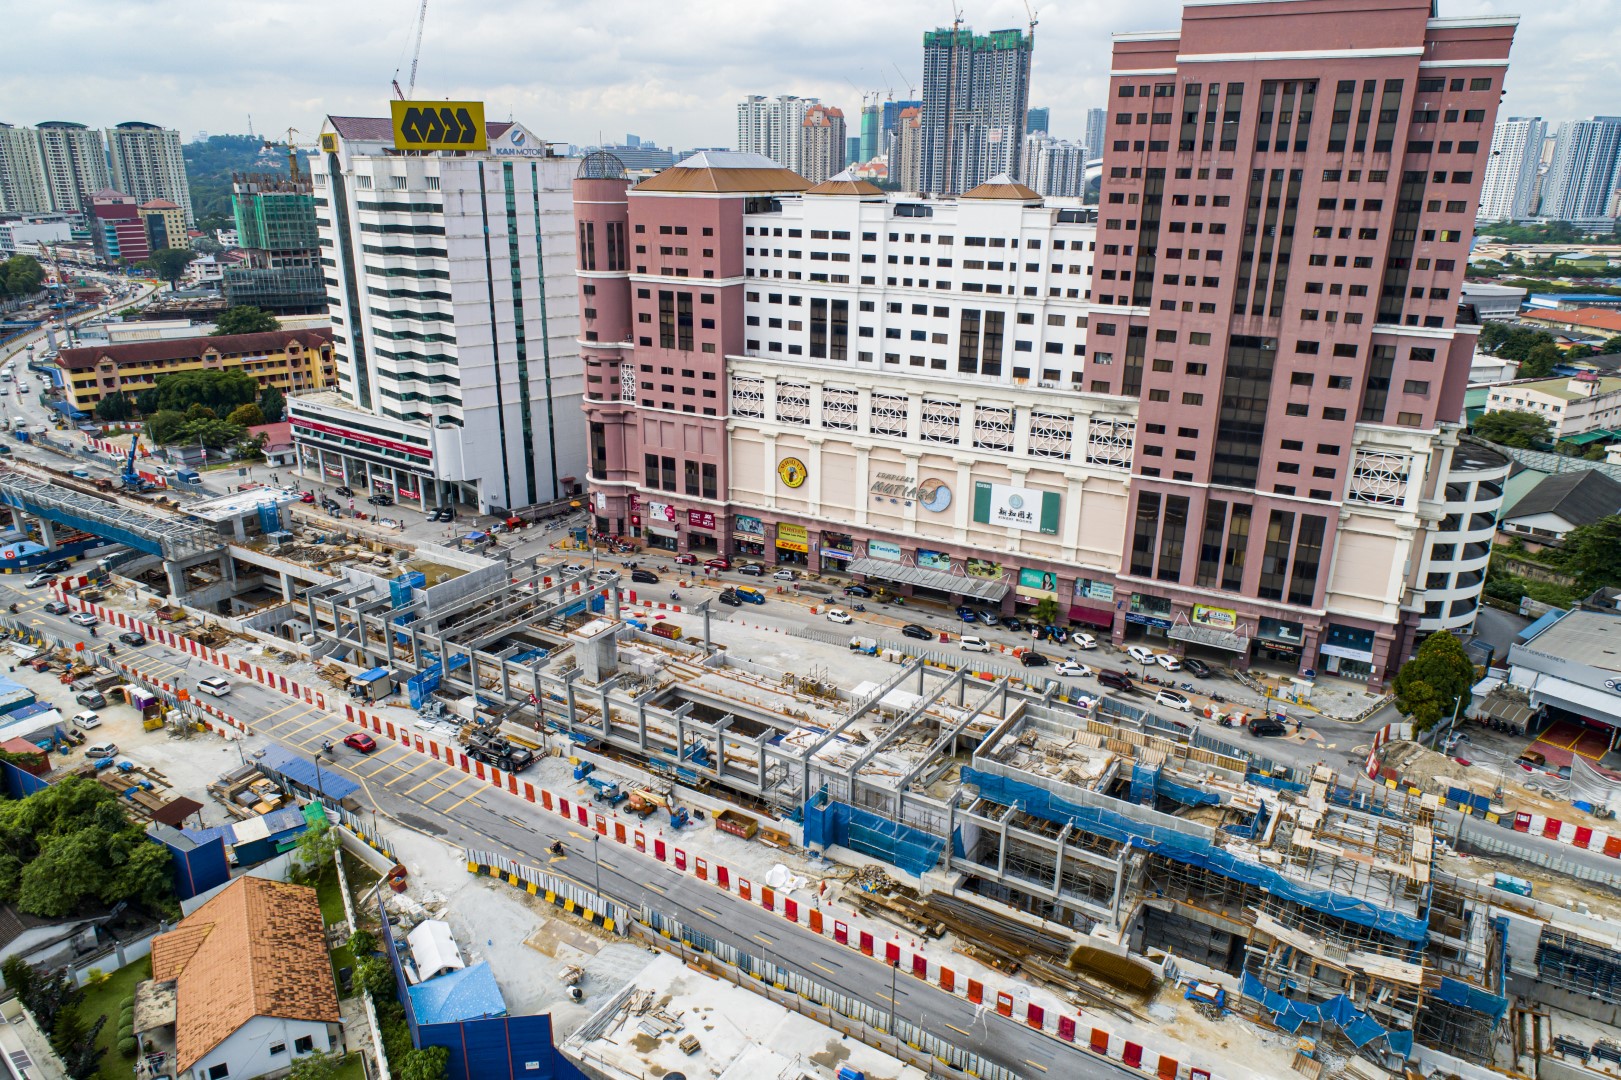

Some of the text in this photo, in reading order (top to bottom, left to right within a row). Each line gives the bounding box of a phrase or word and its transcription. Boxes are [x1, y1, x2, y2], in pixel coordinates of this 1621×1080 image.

[871, 481, 936, 500] MUTIARA
[781, 541, 803, 551] DHL
[876, 545, 900, 554] FamilyMart
[1546, 654, 1566, 664] KERETA
